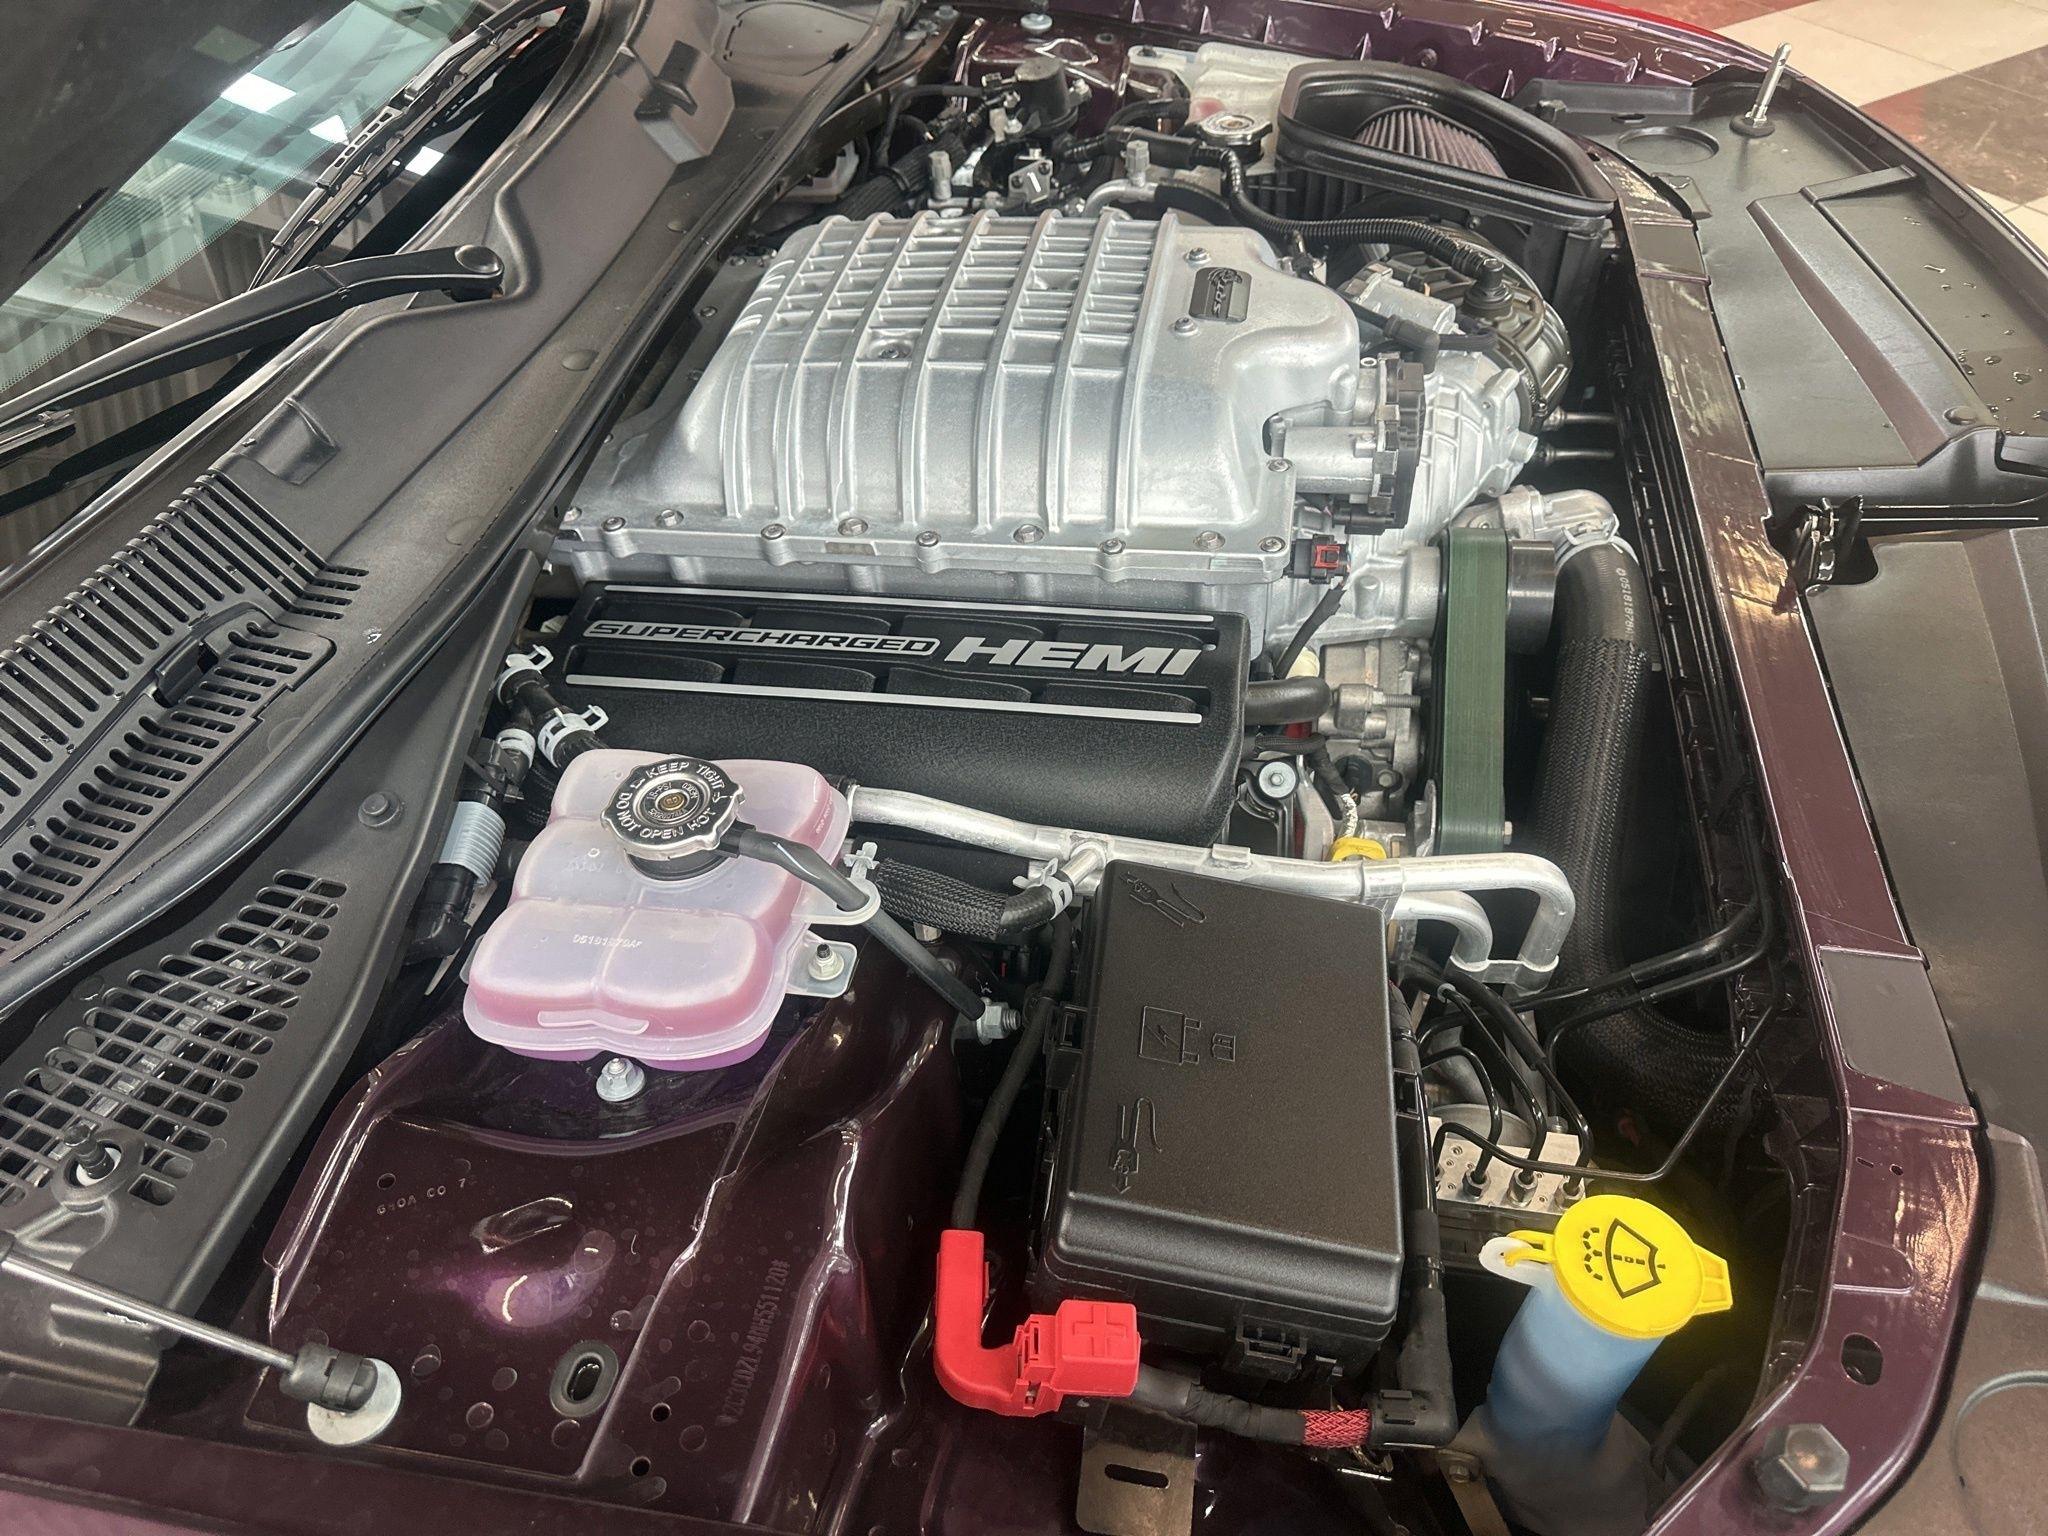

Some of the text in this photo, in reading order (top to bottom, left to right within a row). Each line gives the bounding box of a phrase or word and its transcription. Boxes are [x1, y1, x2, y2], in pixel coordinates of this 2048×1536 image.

[1213, 281, 1226, 314] SRT
[589, 623, 1202, 676] SUPERCHARGED HEMI
[645, 762, 726, 790] KEEP TIGHT
[615, 791, 633, 810] DO
[616, 809, 642, 832] NOT
[686, 807, 717, 831] HOT
[639, 826, 685, 840] OPEN
